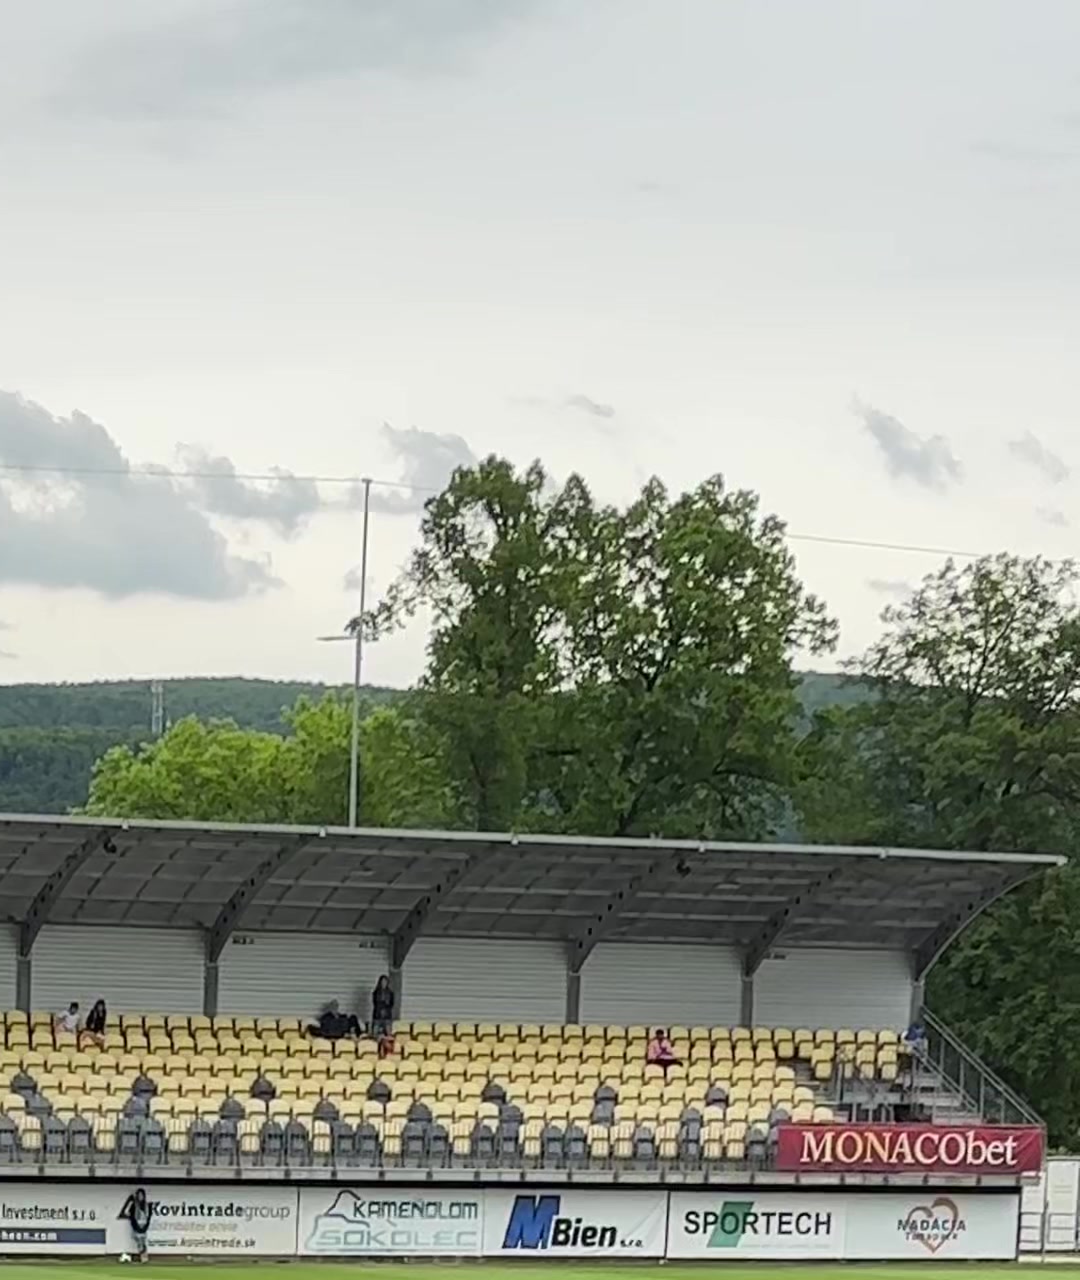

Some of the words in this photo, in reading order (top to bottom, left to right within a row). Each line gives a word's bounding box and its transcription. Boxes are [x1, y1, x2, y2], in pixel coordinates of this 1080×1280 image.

[800, 1130, 1018, 1165] MONACObet
[2, 1203, 69, 1220] Investment
[683, 1210, 832, 1235] SPORTECH
[550, 1218, 617, 1247] Bien
